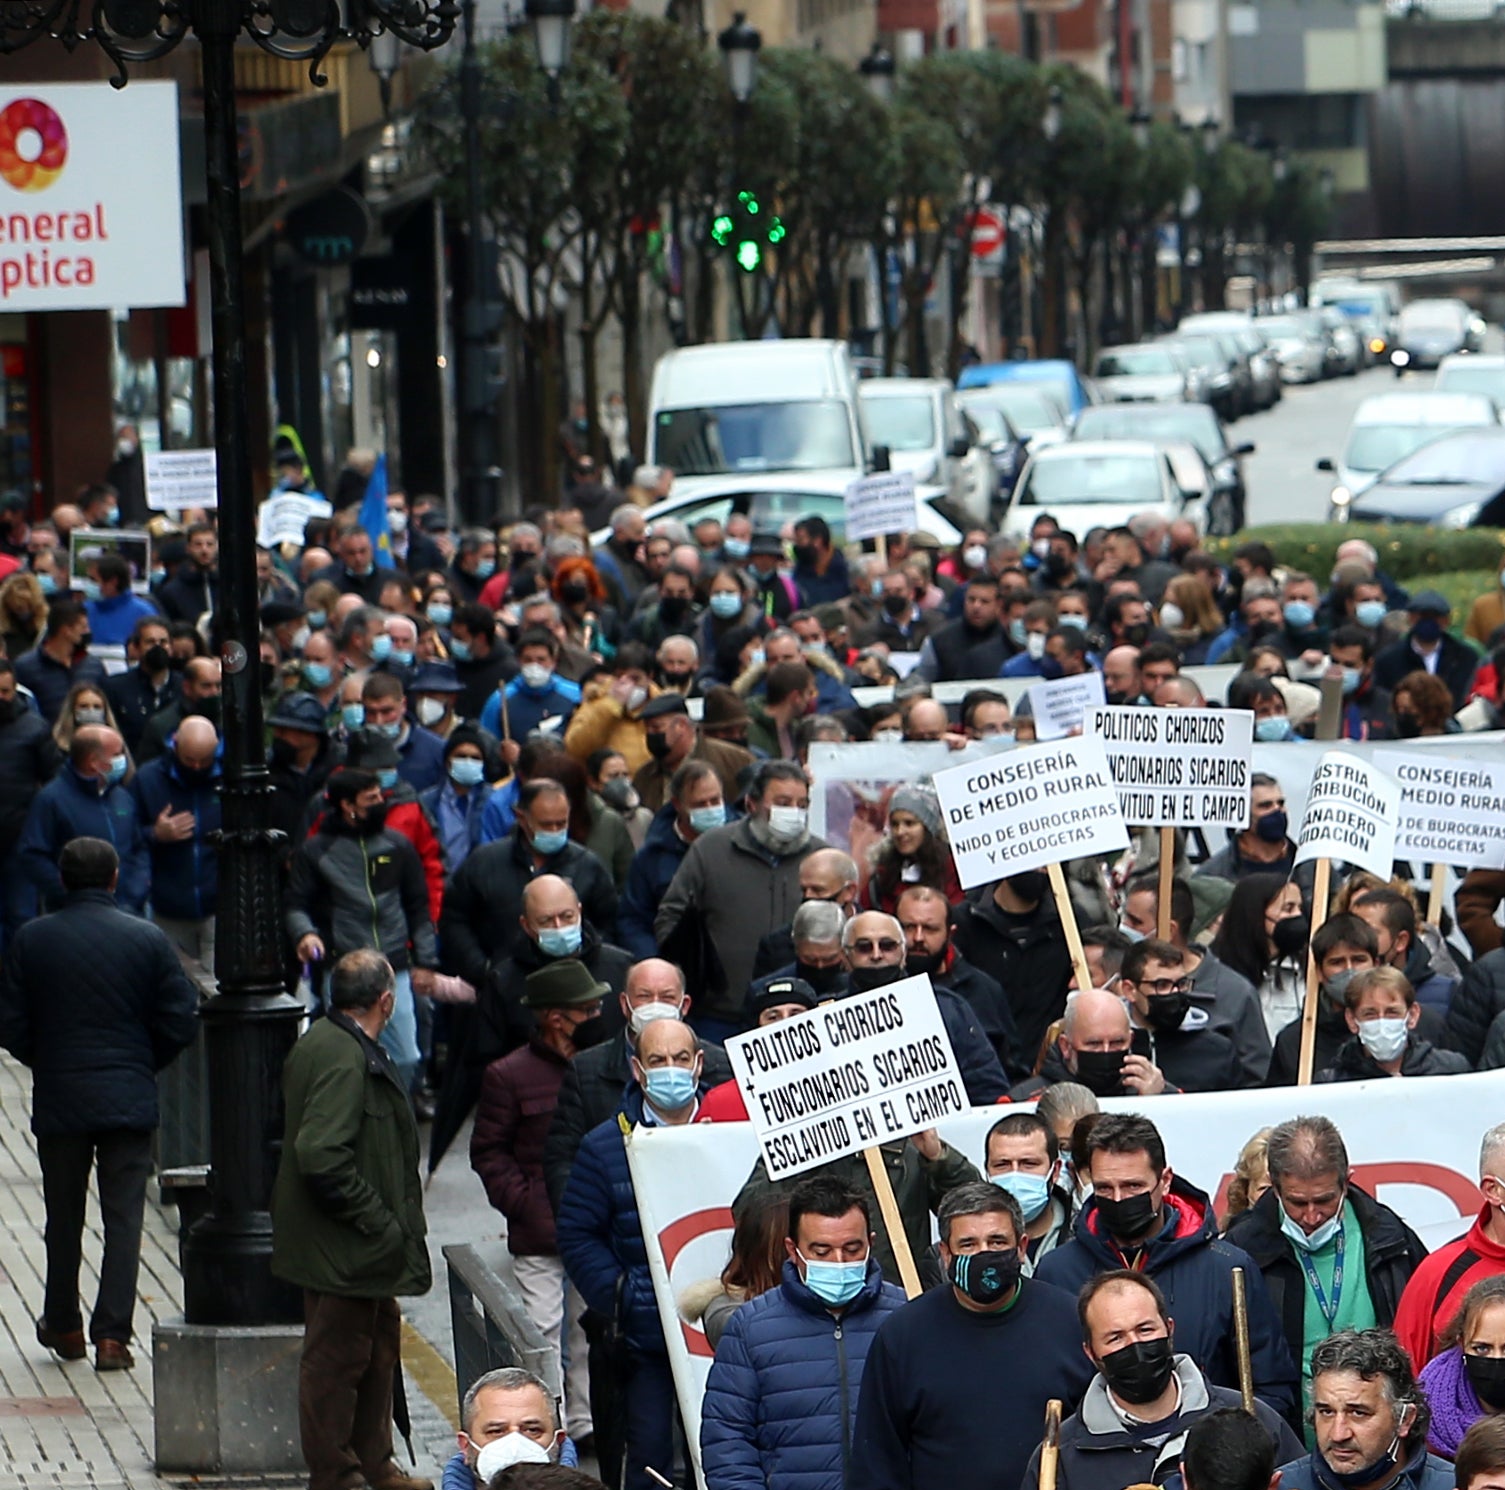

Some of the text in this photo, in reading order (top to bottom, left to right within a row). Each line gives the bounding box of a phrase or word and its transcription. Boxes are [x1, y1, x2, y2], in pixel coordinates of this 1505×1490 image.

[1, 249, 95, 297] ptica
[1095, 712, 1224, 744] POLITICOS CHORIZOS
[966, 750, 1078, 793] CONSEJERÍA
[1109, 754, 1246, 787] NCIONARIOS SICARIOS
[1397, 764, 1493, 789] CONSEJERÍA
[949, 772, 1107, 824] DE MEDIO RURAL
[1119, 792, 1245, 822] VITUD EN EL CAMPO
[1401, 787, 1455, 807] MEDIO
[955, 803, 1117, 855] NIDO DE BUROCRATAS
[1406, 817, 1423, 830] DE
[987, 825, 1095, 865] Y ECOLOGETAS
[1405, 834, 1486, 855] ECOLOGETAS
[741, 992, 904, 1076] POLITICOS CHORIZOS
[759, 1060, 870, 1126] FUNCIONARIOS
[872, 1034, 947, 1088] SICARIOS
[764, 1079, 962, 1172] ESCLAVITUD EN EL CAMPO
